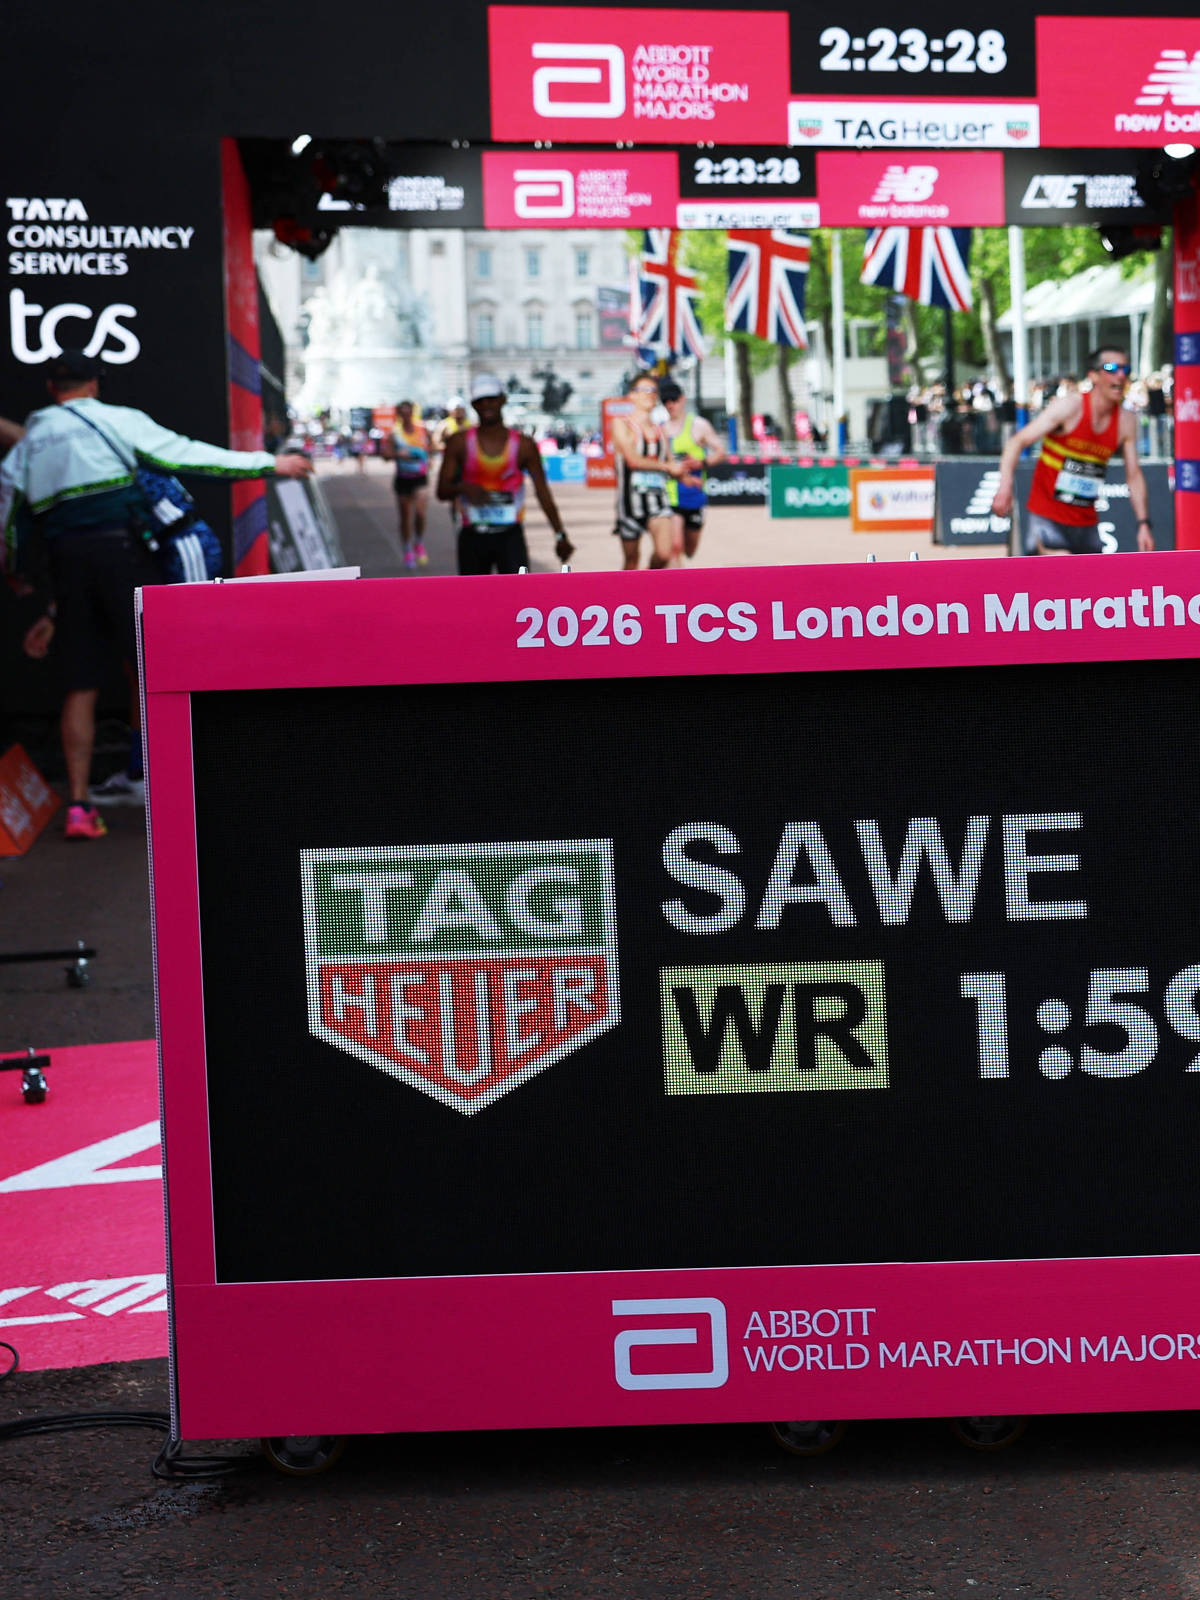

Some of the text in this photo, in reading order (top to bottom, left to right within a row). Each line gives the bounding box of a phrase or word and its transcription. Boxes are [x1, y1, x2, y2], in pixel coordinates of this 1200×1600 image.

[634, 45, 713, 65] ABBOTT
[819, 26, 1008, 74] 2:23:28
[633, 64, 709, 82] WORLD
[633, 83, 748, 101] MARATHON
[634, 101, 715, 120] MAJORS
[1114, 112, 1162, 132] new
[694, 157, 800, 185] 2:23:28
[6, 197, 89, 222] TATA
[7, 224, 195, 250] CONSULTANCY
[9, 251, 130, 276] SERVICES
[9, 287, 141, 364] tcs
[515, 602, 641, 649] 2026
[655, 601, 758, 643] TCS
[771, 594, 969, 640] London
[660, 811, 1089, 935] SAWE
[331, 865, 584, 945] TAG
[331, 966, 597, 1084] HEUER
[671, 981, 875, 1075] WR
[743, 1307, 876, 1339] ABBOTT
[742, 1342, 870, 1372] WORLD
[879, 1336, 1071, 1368] MARATHON
